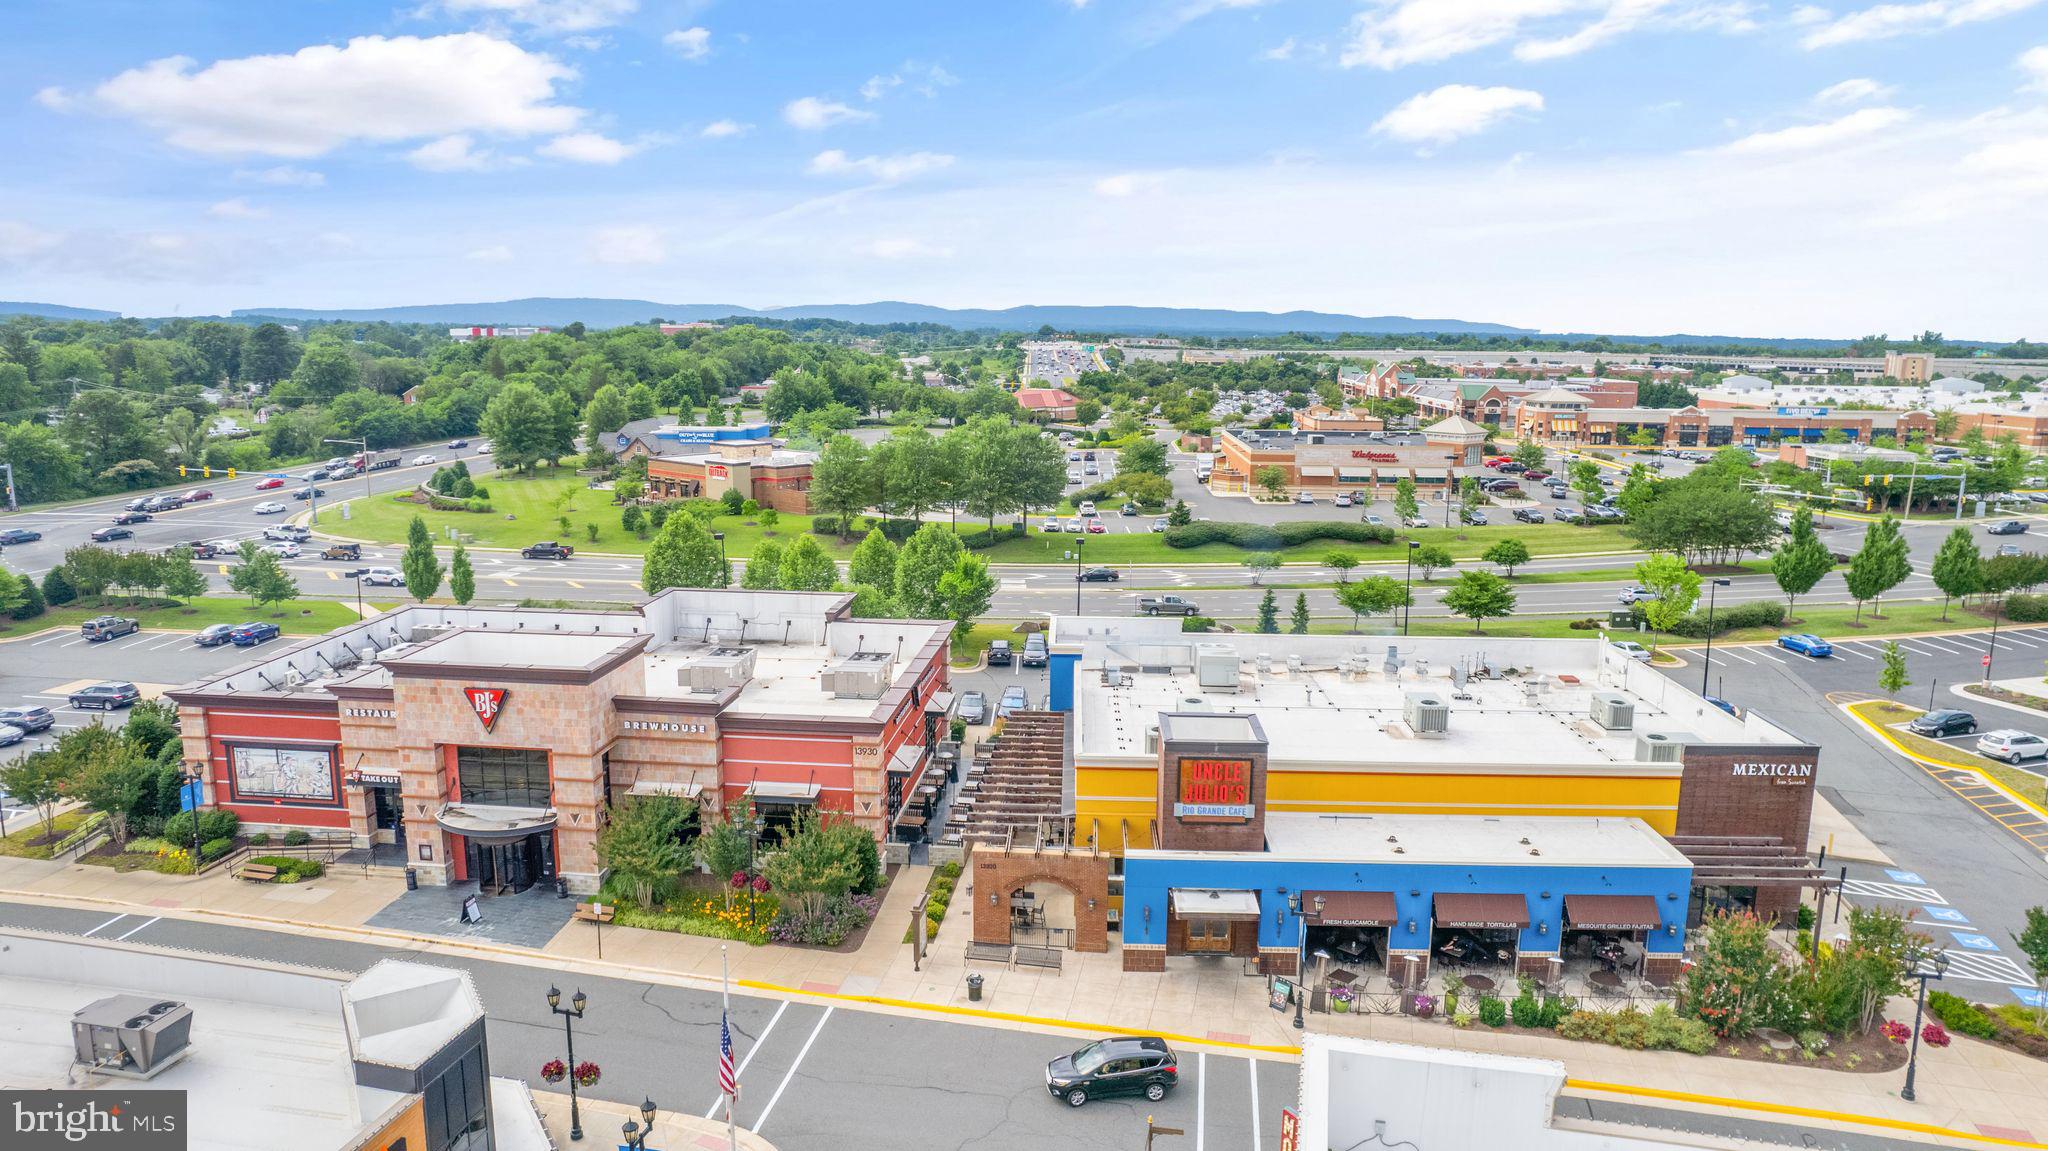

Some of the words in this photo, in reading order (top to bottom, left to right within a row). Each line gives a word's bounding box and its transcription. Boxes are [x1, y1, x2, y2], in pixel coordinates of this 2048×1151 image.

[1352, 450, 1397, 460] Walgreens
[624, 721, 706, 734] BREWHOUSE
[854, 747, 878, 756] 13930
[1192, 761, 1243, 782] UNCLE
[1732, 763, 1813, 777] MEXICAN
[360, 774, 381, 783] TAKE
[381, 776, 399, 784] OUT
[1183, 783, 1246, 804] JULIO'S
[1182, 805, 1195, 815] RIO
